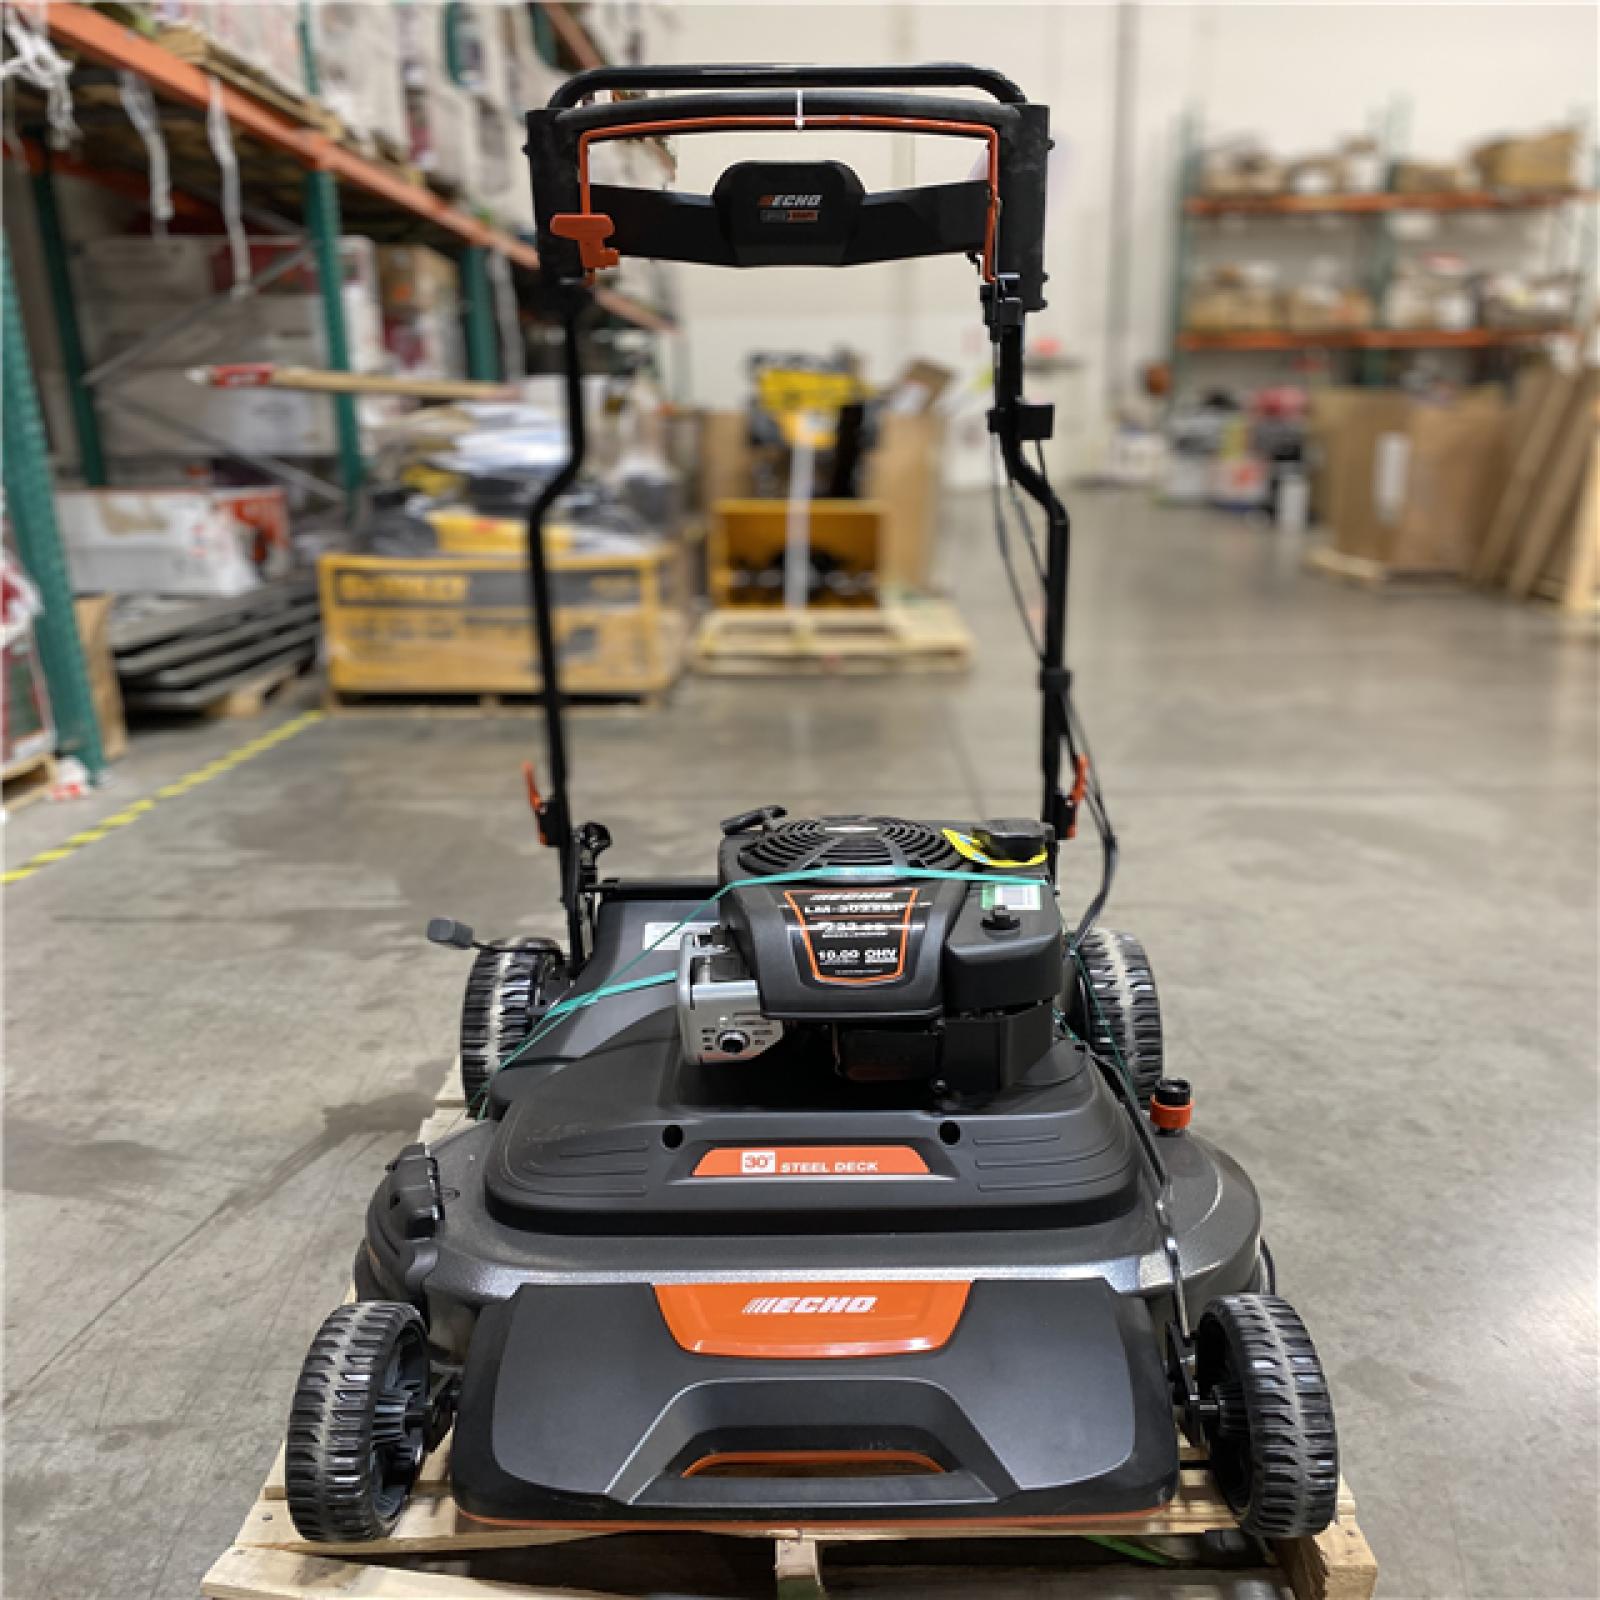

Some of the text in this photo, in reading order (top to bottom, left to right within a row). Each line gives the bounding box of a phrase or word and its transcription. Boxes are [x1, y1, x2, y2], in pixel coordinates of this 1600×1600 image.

[771, 194, 822, 206] ECHO
[781, 1161, 829, 1173] STEEL
[834, 1160, 879, 1172] DECK
[771, 1296, 878, 1314] ECHO
